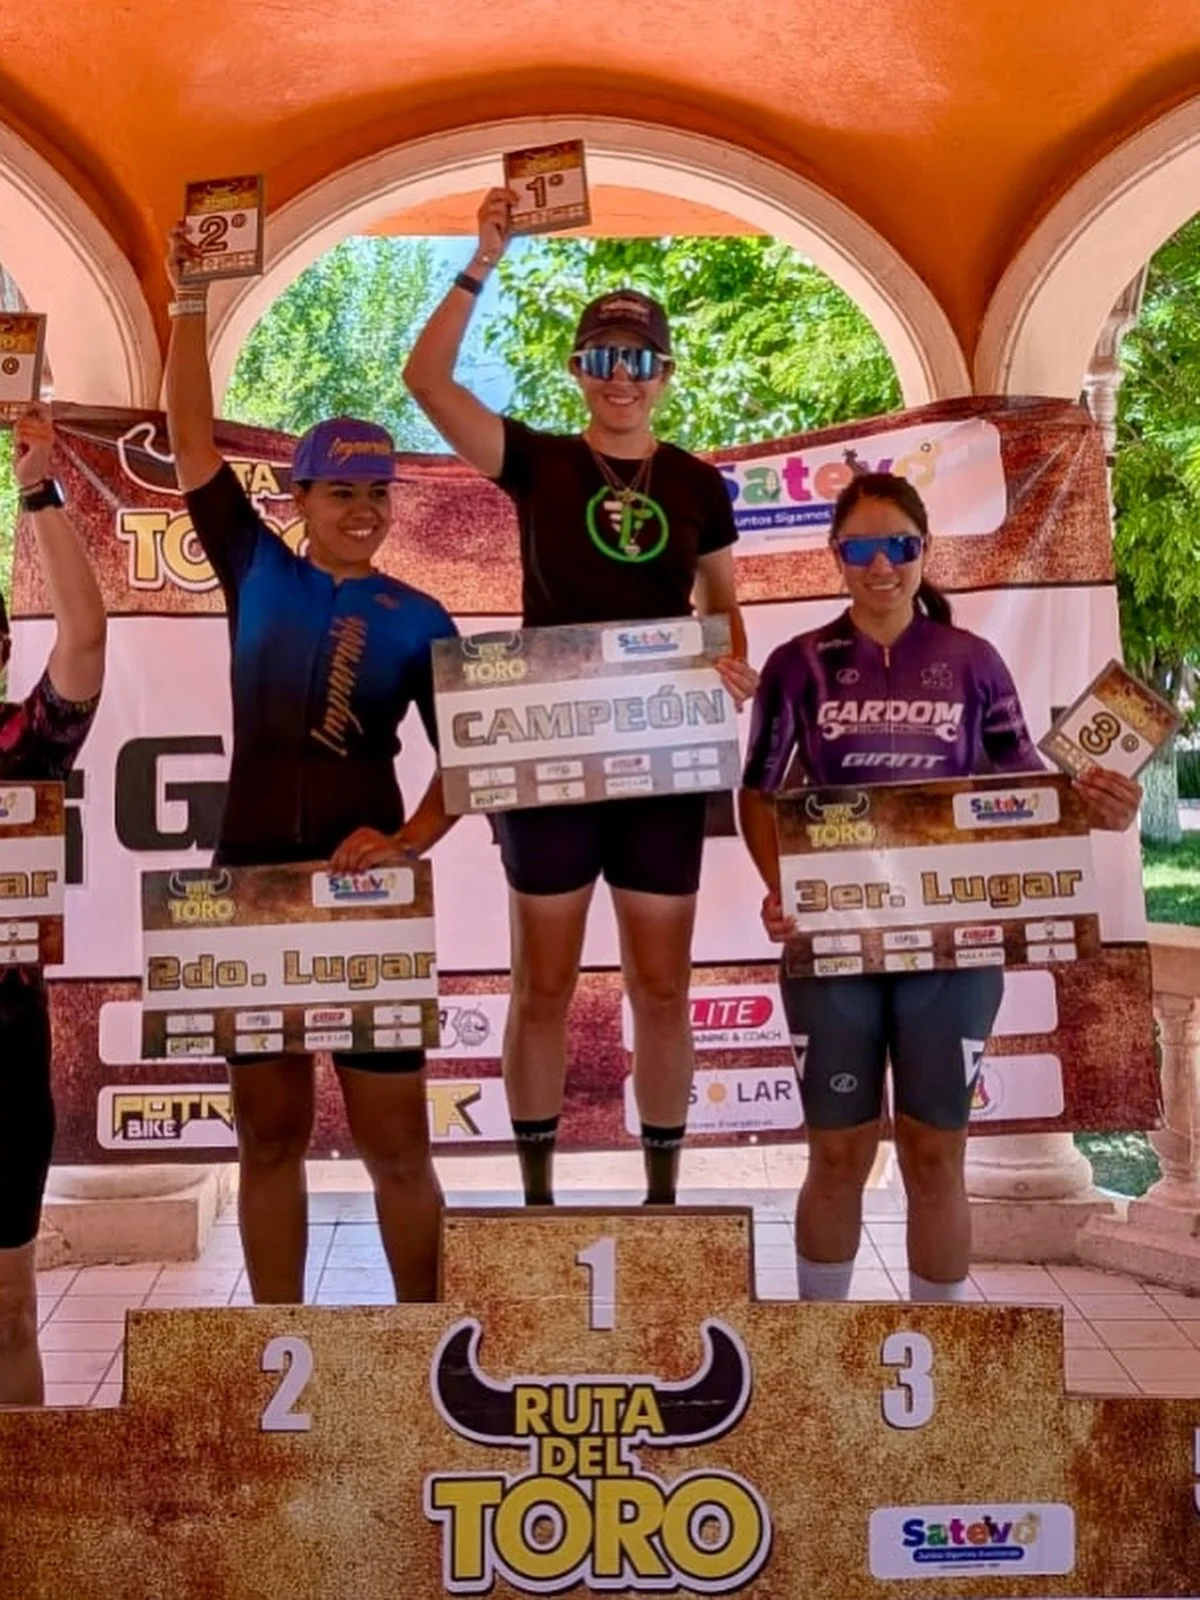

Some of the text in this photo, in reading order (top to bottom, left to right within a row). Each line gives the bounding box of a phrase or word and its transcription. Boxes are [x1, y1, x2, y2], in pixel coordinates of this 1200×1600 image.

[453, 685, 725, 748] CAMPEÓN
[818, 702, 963, 725] GARDOM
[842, 753, 946, 769] GIANT
[795, 869, 1083, 913] 3er. Lugar
[147, 949, 436, 991] 2do. Lugar
[690, 1001, 756, 1027] LITE
[127, 1119, 178, 1138] BIKE
[575, 1237, 618, 1330] 1
[260, 1336, 314, 1430] 2
[881, 1331, 935, 1430] 3
[515, 1385, 665, 1435] RUTA
[539, 1436, 634, 1477] DEL
[432, 1478, 763, 1581] TORO
